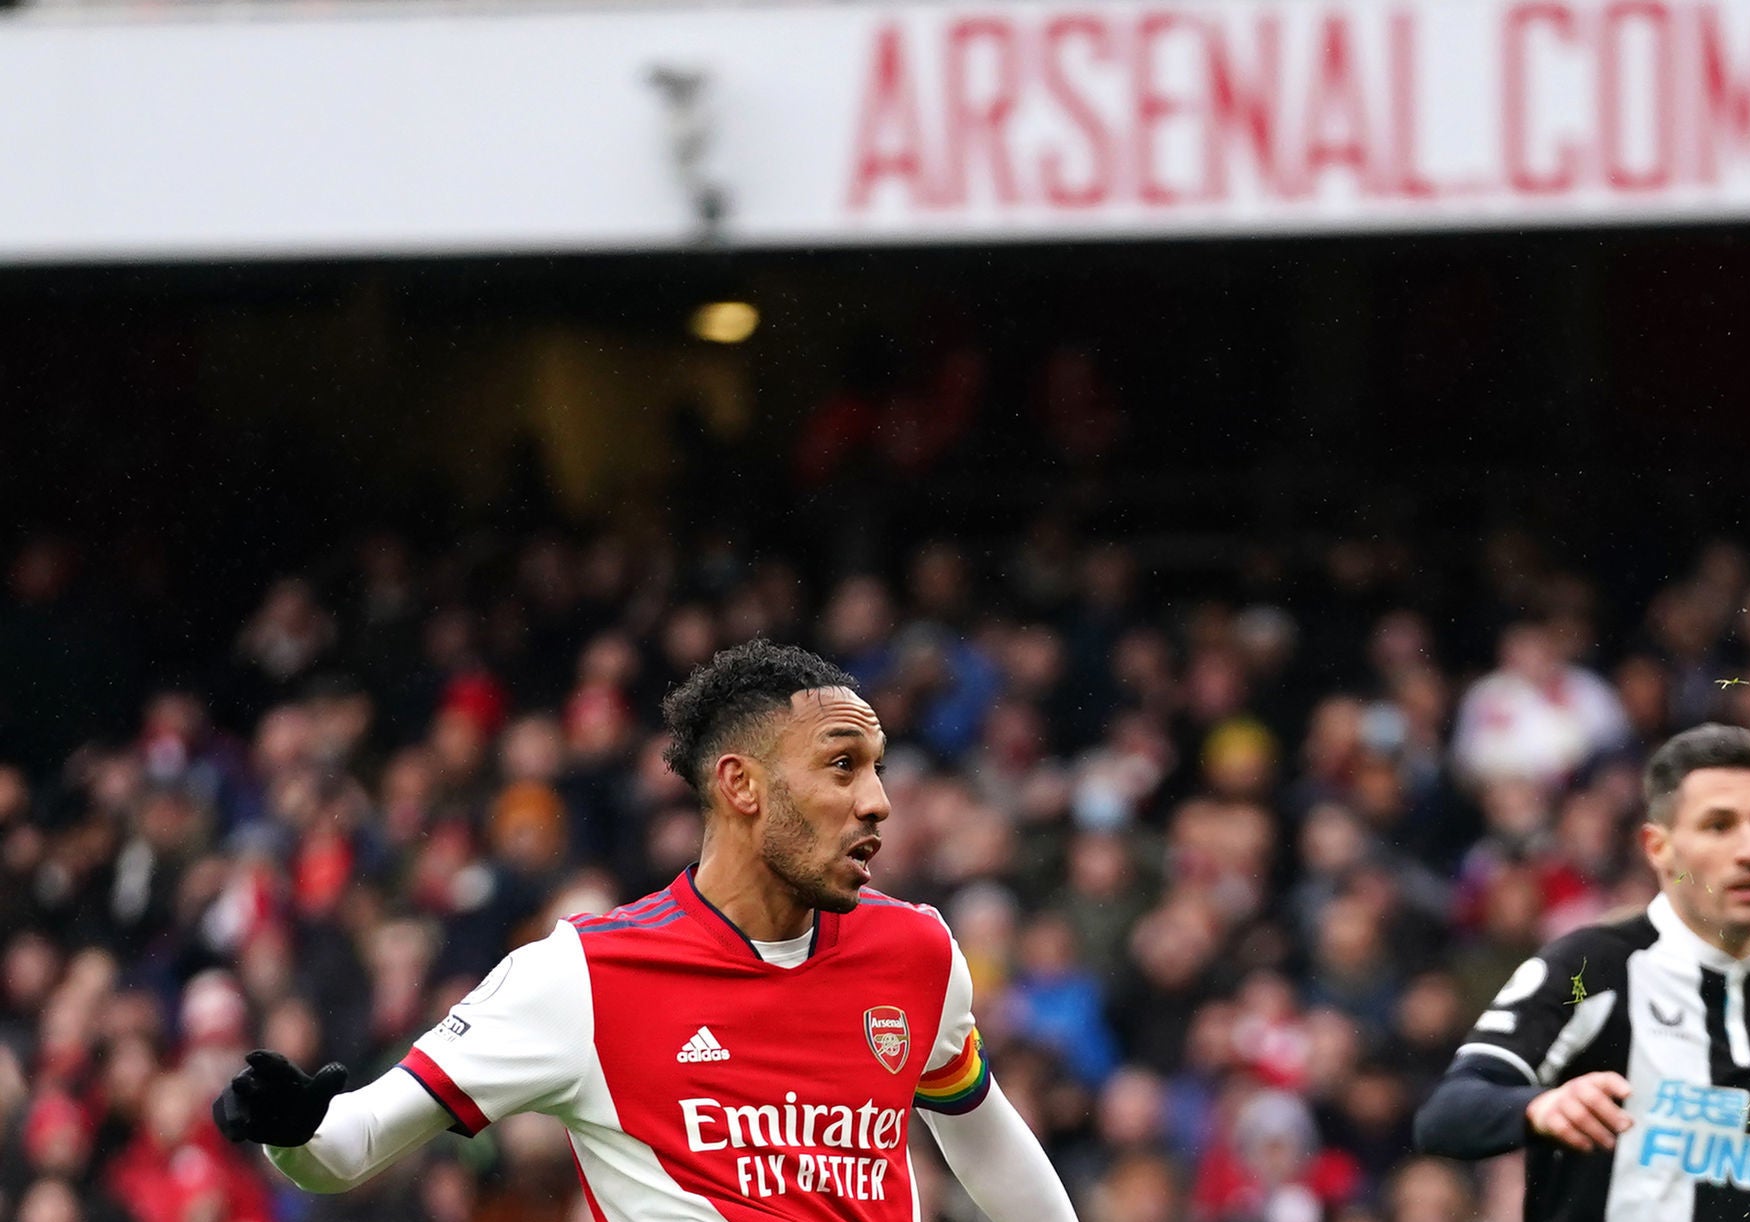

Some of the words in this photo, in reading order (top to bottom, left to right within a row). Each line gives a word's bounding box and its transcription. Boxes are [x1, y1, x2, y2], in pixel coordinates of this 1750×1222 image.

[871, 1017, 905, 1029] Arsenal
[676, 1048, 731, 1063] adidas
[678, 1091, 905, 1153] Emirates
[736, 1154, 786, 1198] FLY
[796, 1153, 888, 1201] BETTER
